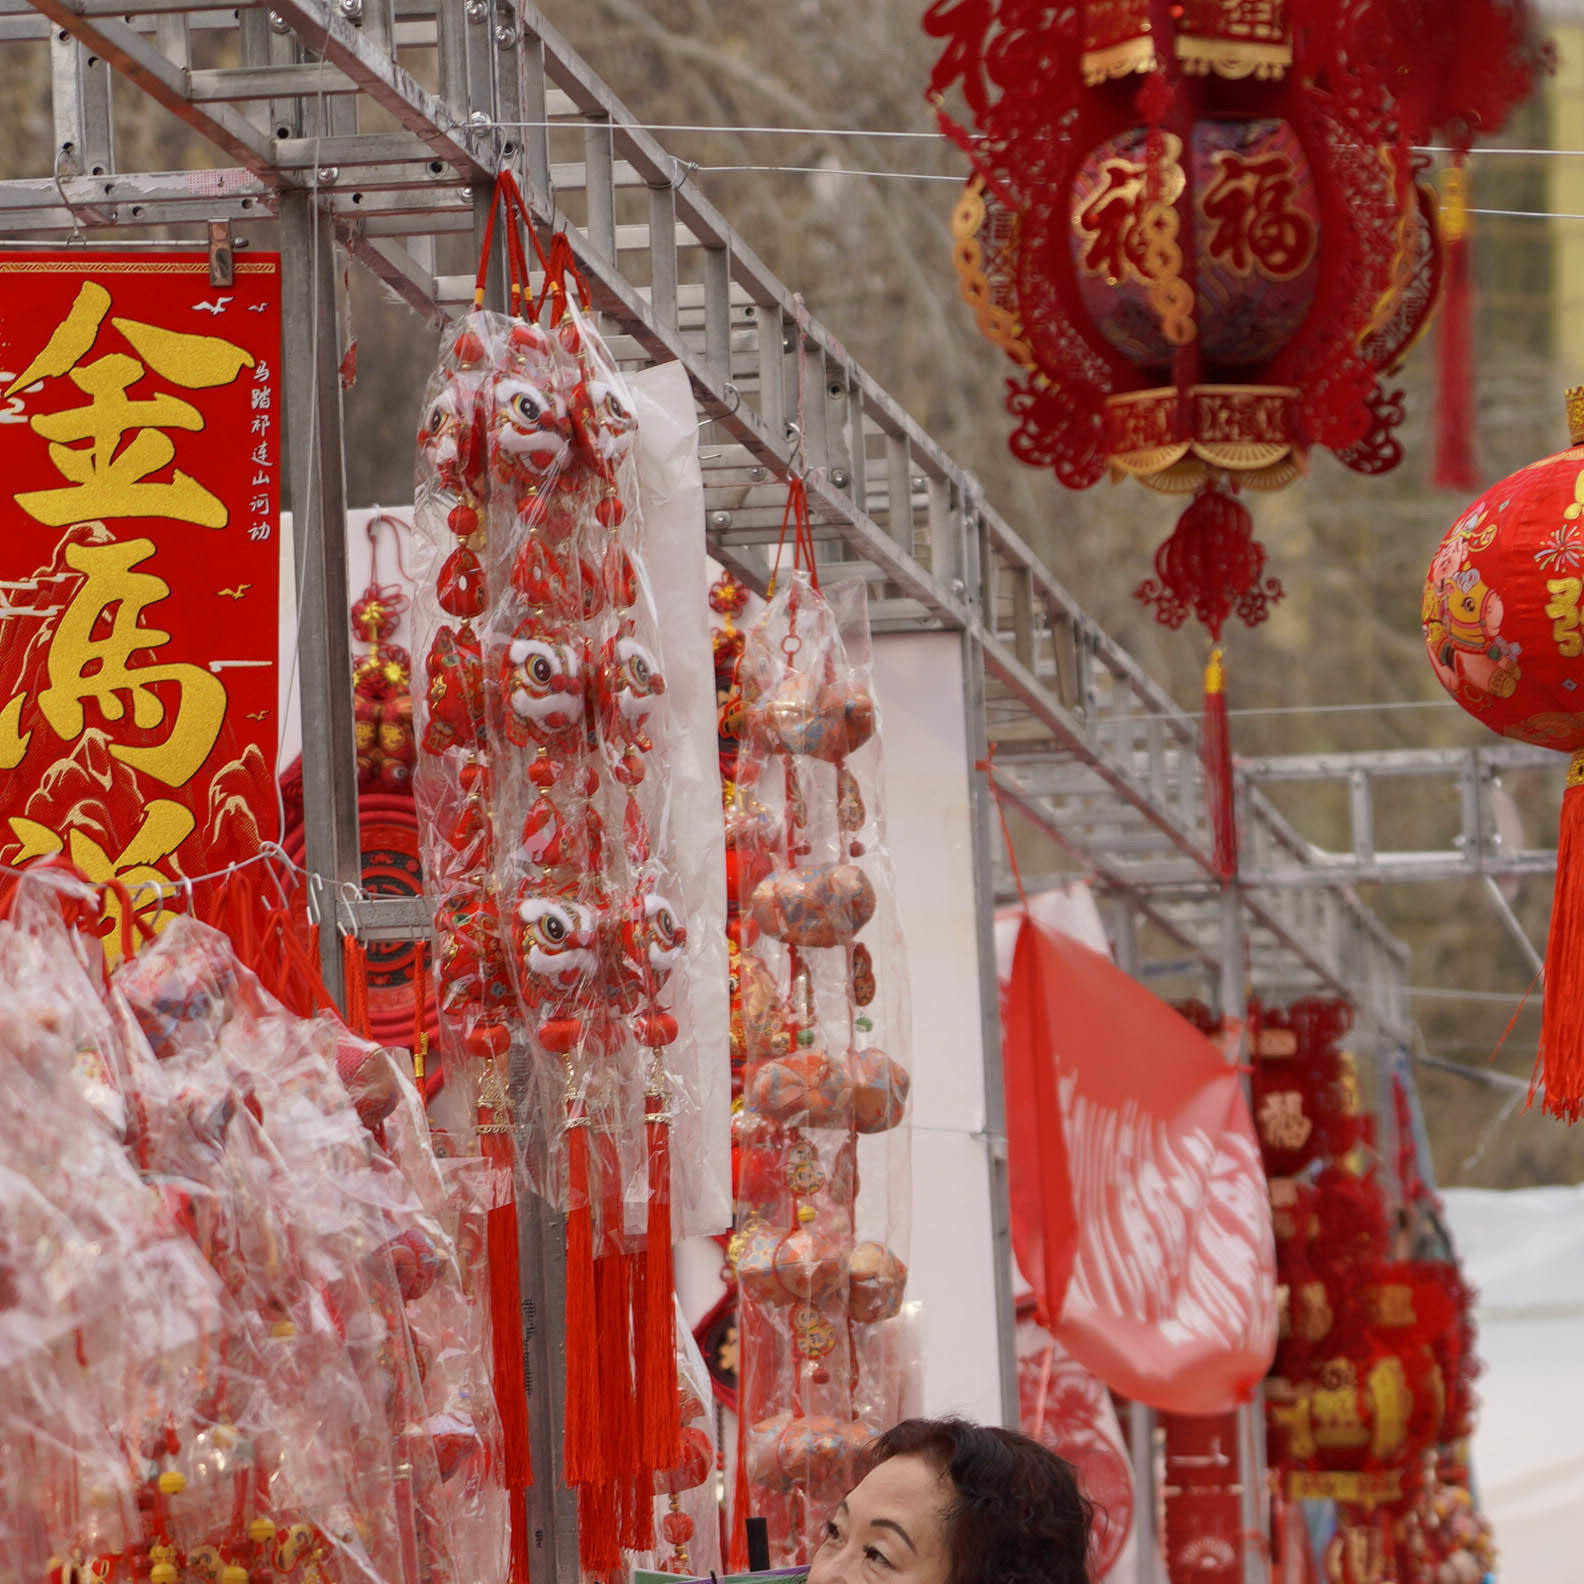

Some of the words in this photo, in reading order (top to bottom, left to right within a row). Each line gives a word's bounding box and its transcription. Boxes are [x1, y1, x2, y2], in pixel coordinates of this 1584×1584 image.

[1201, 149, 1317, 279] 福
[248, 359, 272, 541] 马踏祁连山河动
